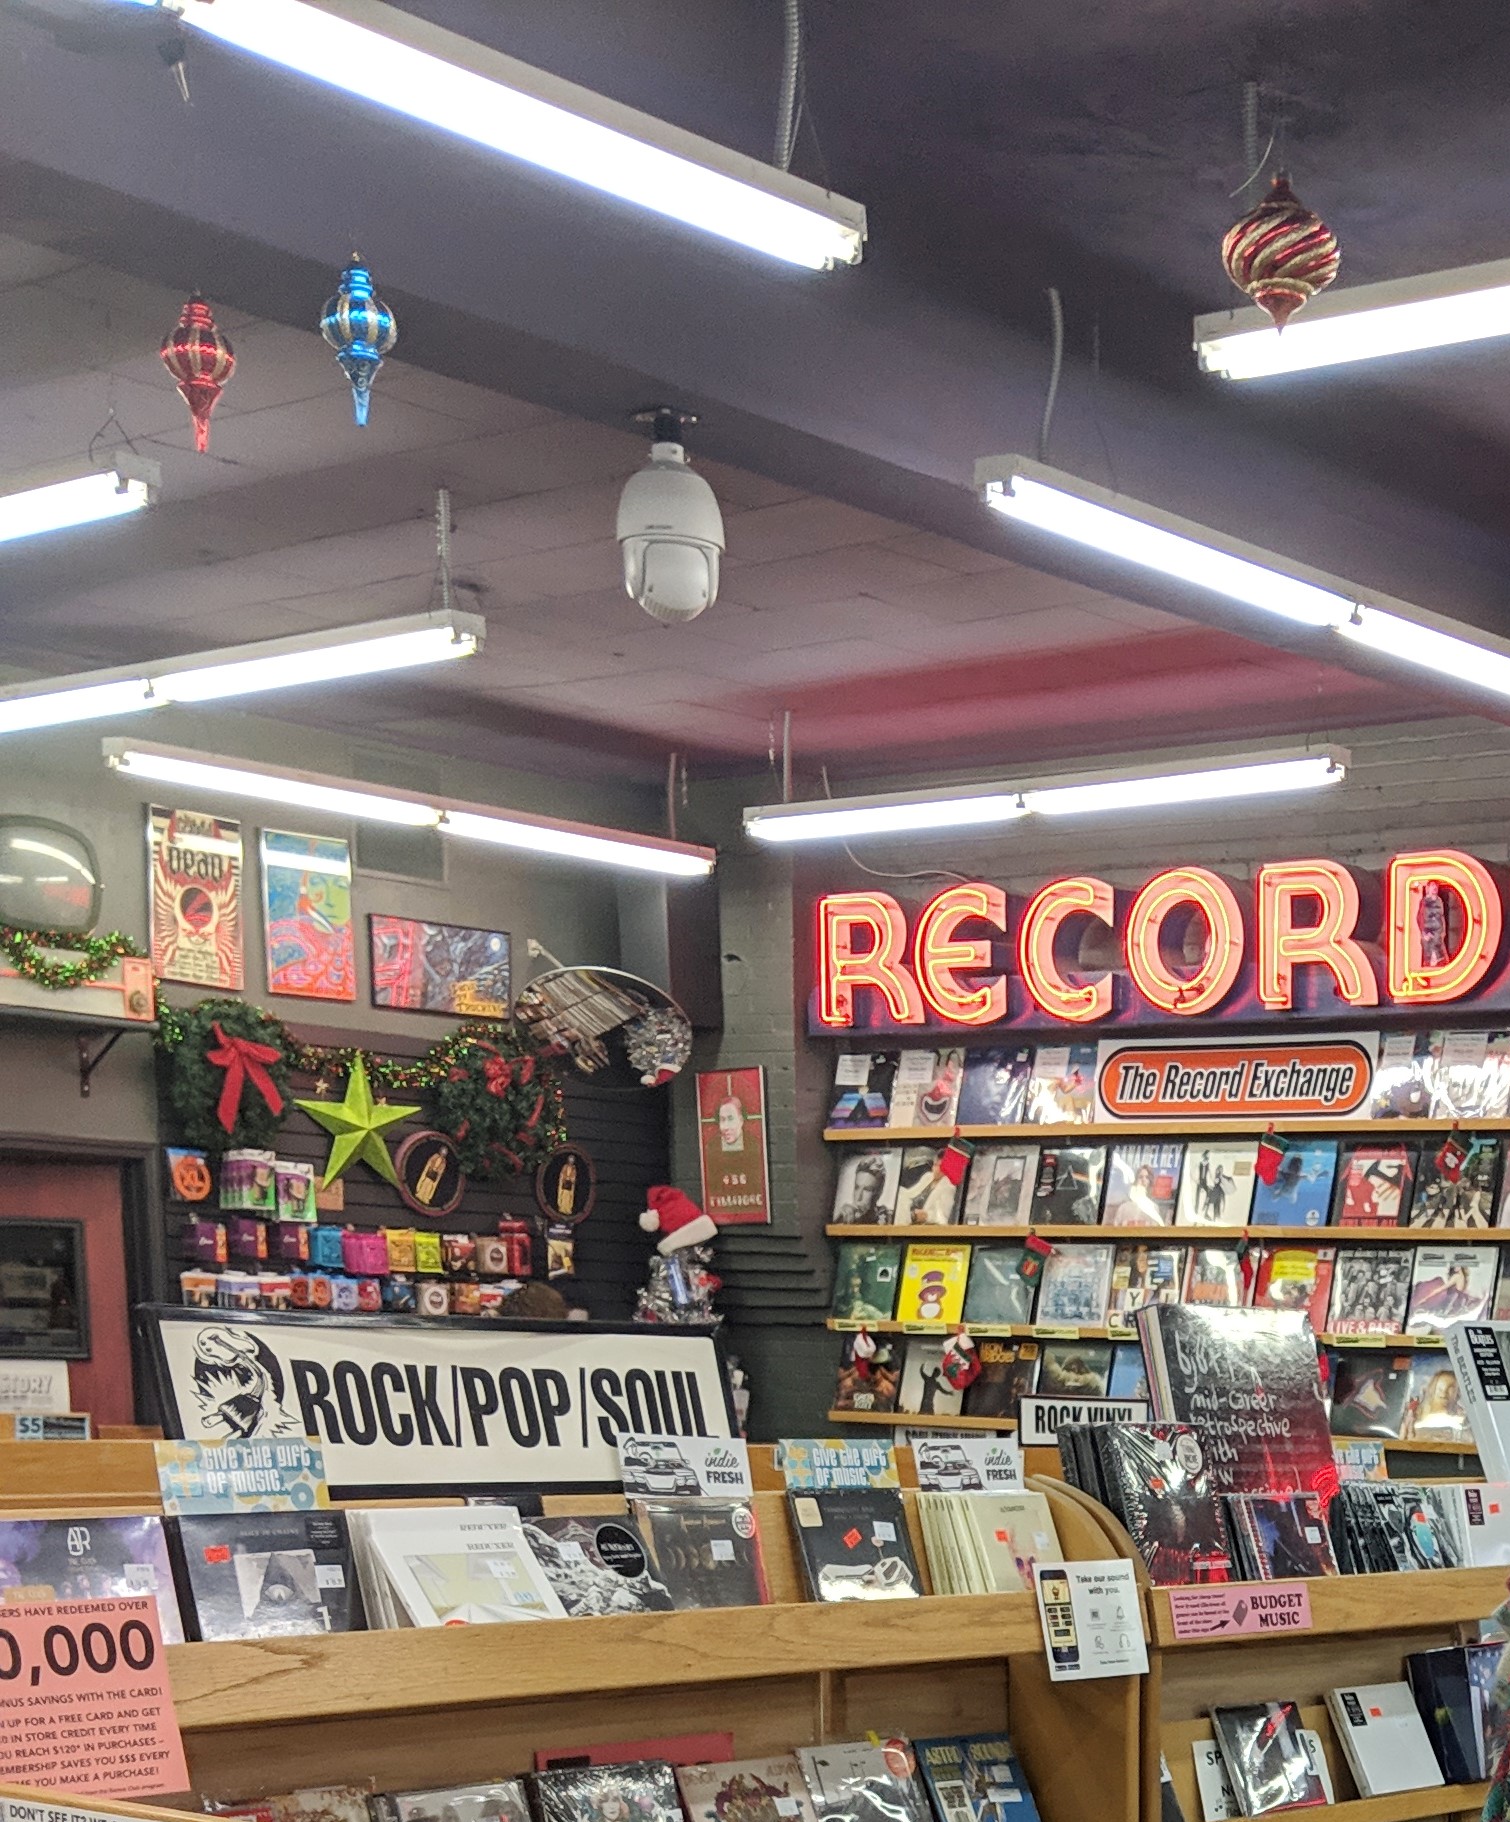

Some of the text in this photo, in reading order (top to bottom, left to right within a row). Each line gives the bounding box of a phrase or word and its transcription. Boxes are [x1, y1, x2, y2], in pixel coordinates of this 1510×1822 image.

[1119, 1060, 1354, 1102] The Record Exchange
[1035, 1405, 1083, 1434] ROCK
[706, 1470, 744, 1485] FRESH
[986, 1468, 1017, 1481] FRESH
[1075, 1574, 1093, 1583] Take
[1107, 1573, 1130, 1582] sound
[1088, 1586, 1120, 1596] with you.
[25, 1601, 149, 1616] HAVE REDEEMED OVER
[1250, 1593, 1303, 1610] BUDGET
[1259, 1612, 1300, 1628] MUSIC
[28, 1687, 162, 1706] SAVINGS WITH THE CARD!
[8, 1707, 161, 1728] UP FOR A FREE CARD AND GET
[25, 1722, 157, 1742] STORE CREDIT EVERY TIME
[16, 1737, 156, 1759] REACH IN PURCHASES
[61, 1751, 171, 1769] SAVES YOU EVERY
[35, 1767, 159, 1788] YOU MAKE A PURCHASE!
[9, 1804, 45, 1818] DON'T
